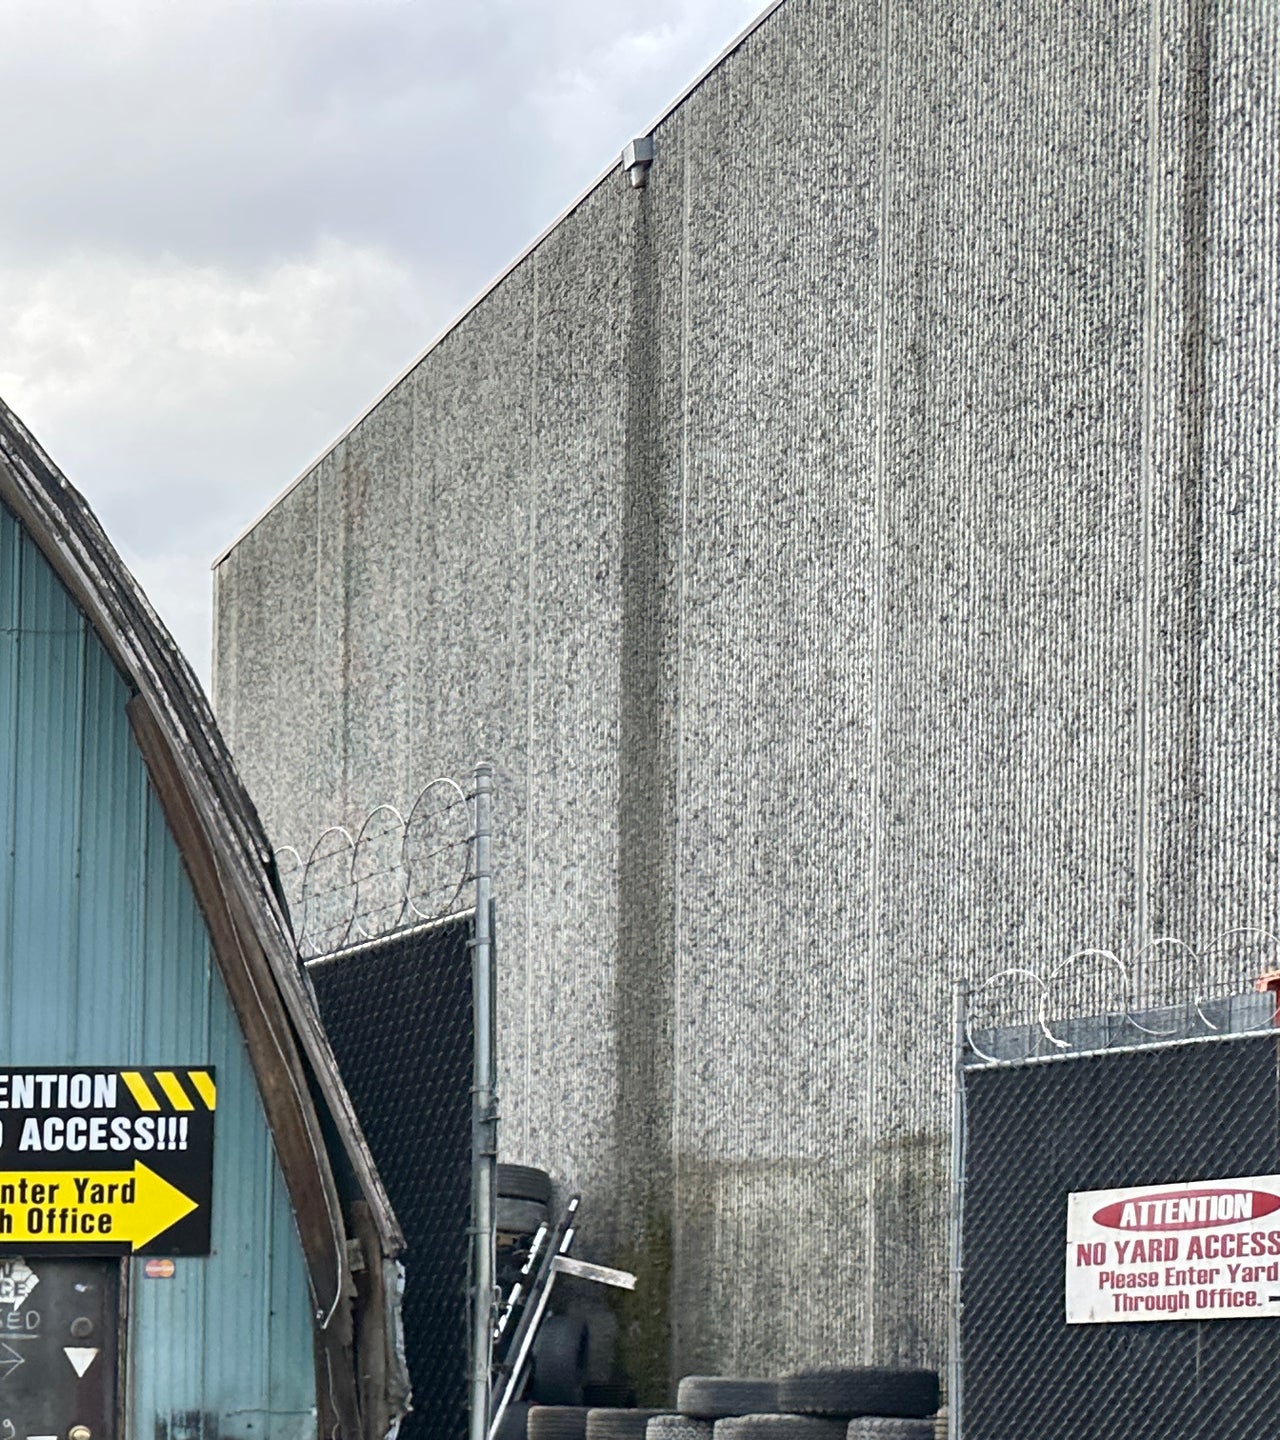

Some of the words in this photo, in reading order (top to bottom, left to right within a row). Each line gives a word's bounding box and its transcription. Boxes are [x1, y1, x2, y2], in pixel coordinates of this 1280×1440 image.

[19, 1115, 189, 1152] ACCESS!!!
[74, 1177, 136, 1205] Yard
[26, 1208, 113, 1234] Office
[1119, 1192, 1253, 1228] ATTENTION
[1076, 1242, 1107, 1267] NO
[1114, 1237, 1179, 1265] YARD
[1098, 1271, 1159, 1291] Please
[1165, 1267, 1220, 1287] Enter
[1227, 1261, 1279, 1283] Yard
[1112, 1290, 1190, 1314] Through
